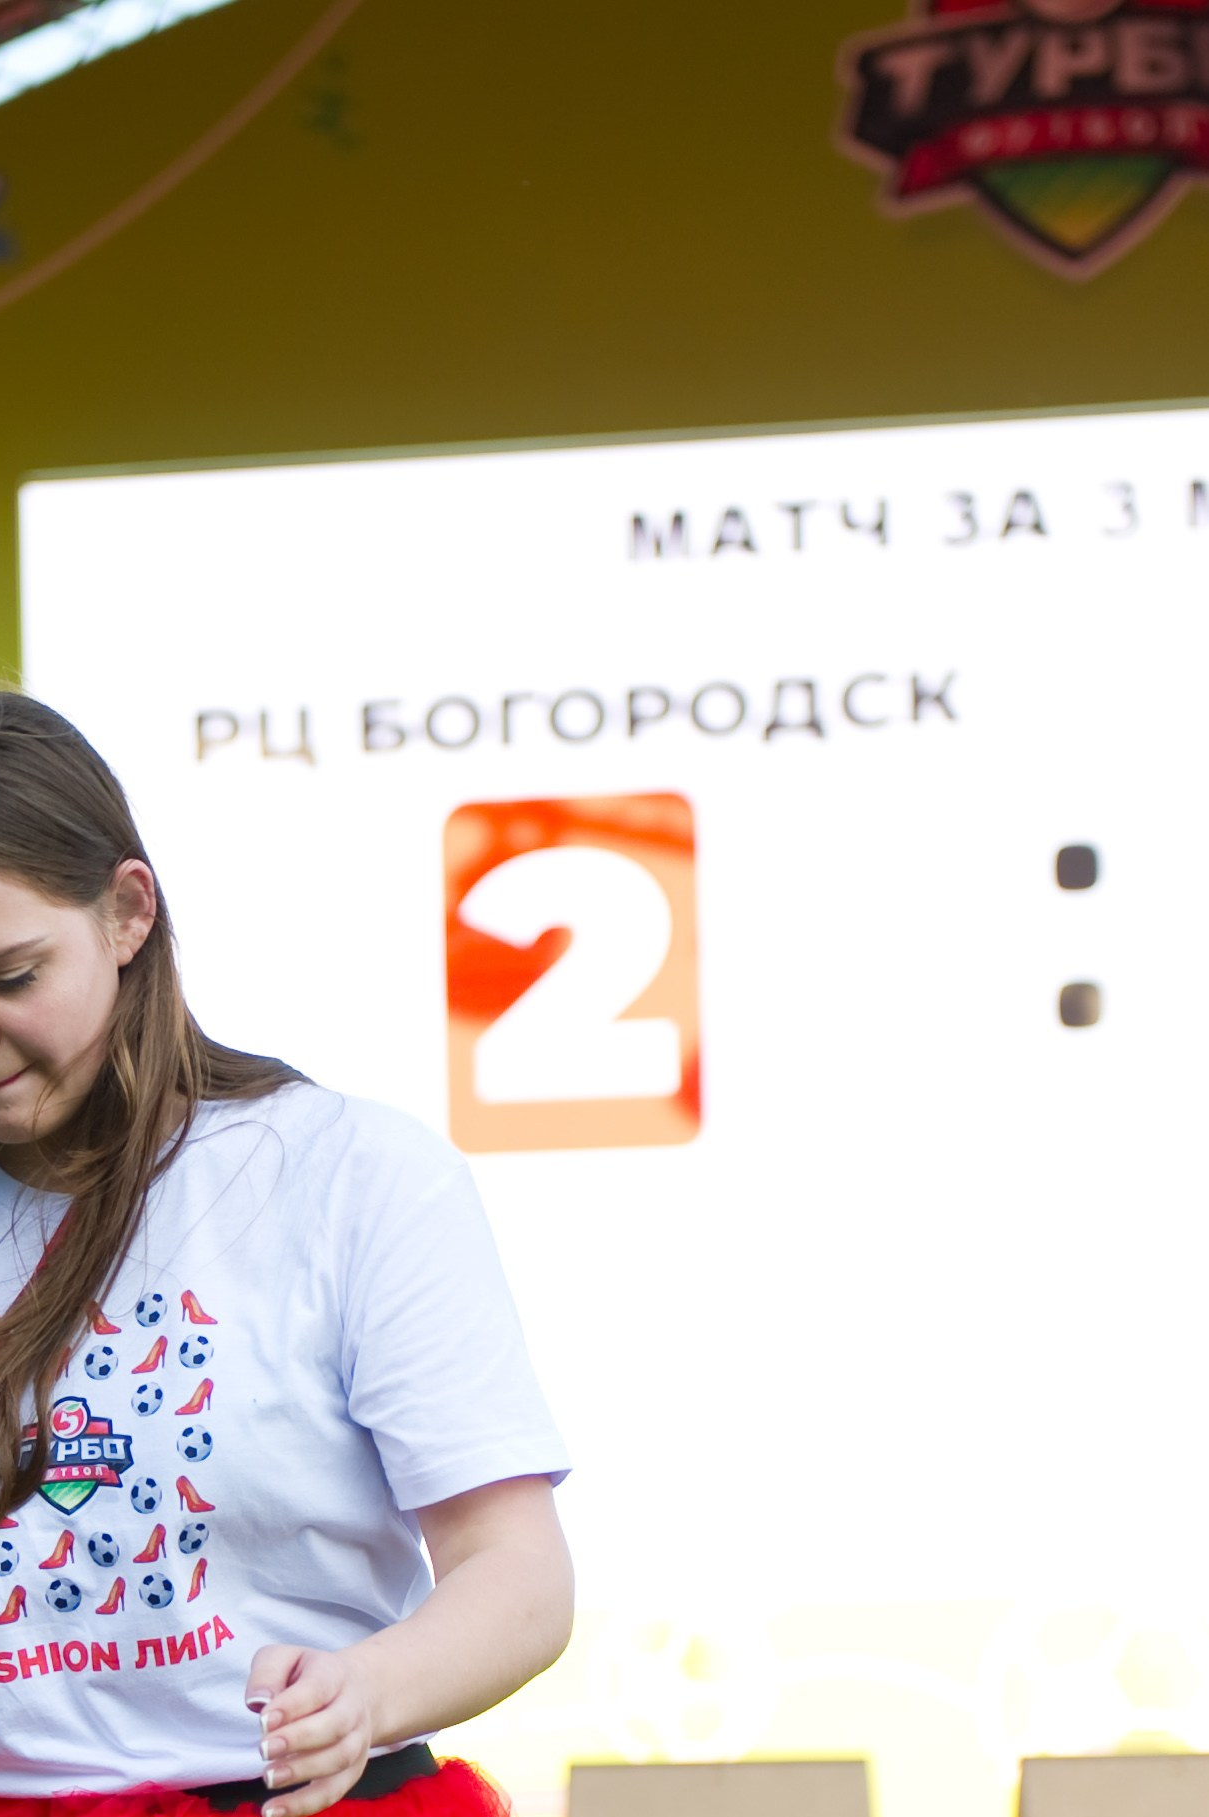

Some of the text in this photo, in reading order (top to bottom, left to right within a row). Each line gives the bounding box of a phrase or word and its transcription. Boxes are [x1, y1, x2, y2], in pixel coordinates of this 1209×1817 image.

[874, 19, 1209, 118] ТУРБ
[625, 496, 891, 562] МАТЧ
[941, 486, 1050, 547] ЗА
[195, 670, 959, 766] РЦ БОГОРОДСК
[457, 844, 682, 1104] 2
[47, 1465, 103, 1478] УТБОЛ
[135, 1614, 234, 1669] ЛИГА
